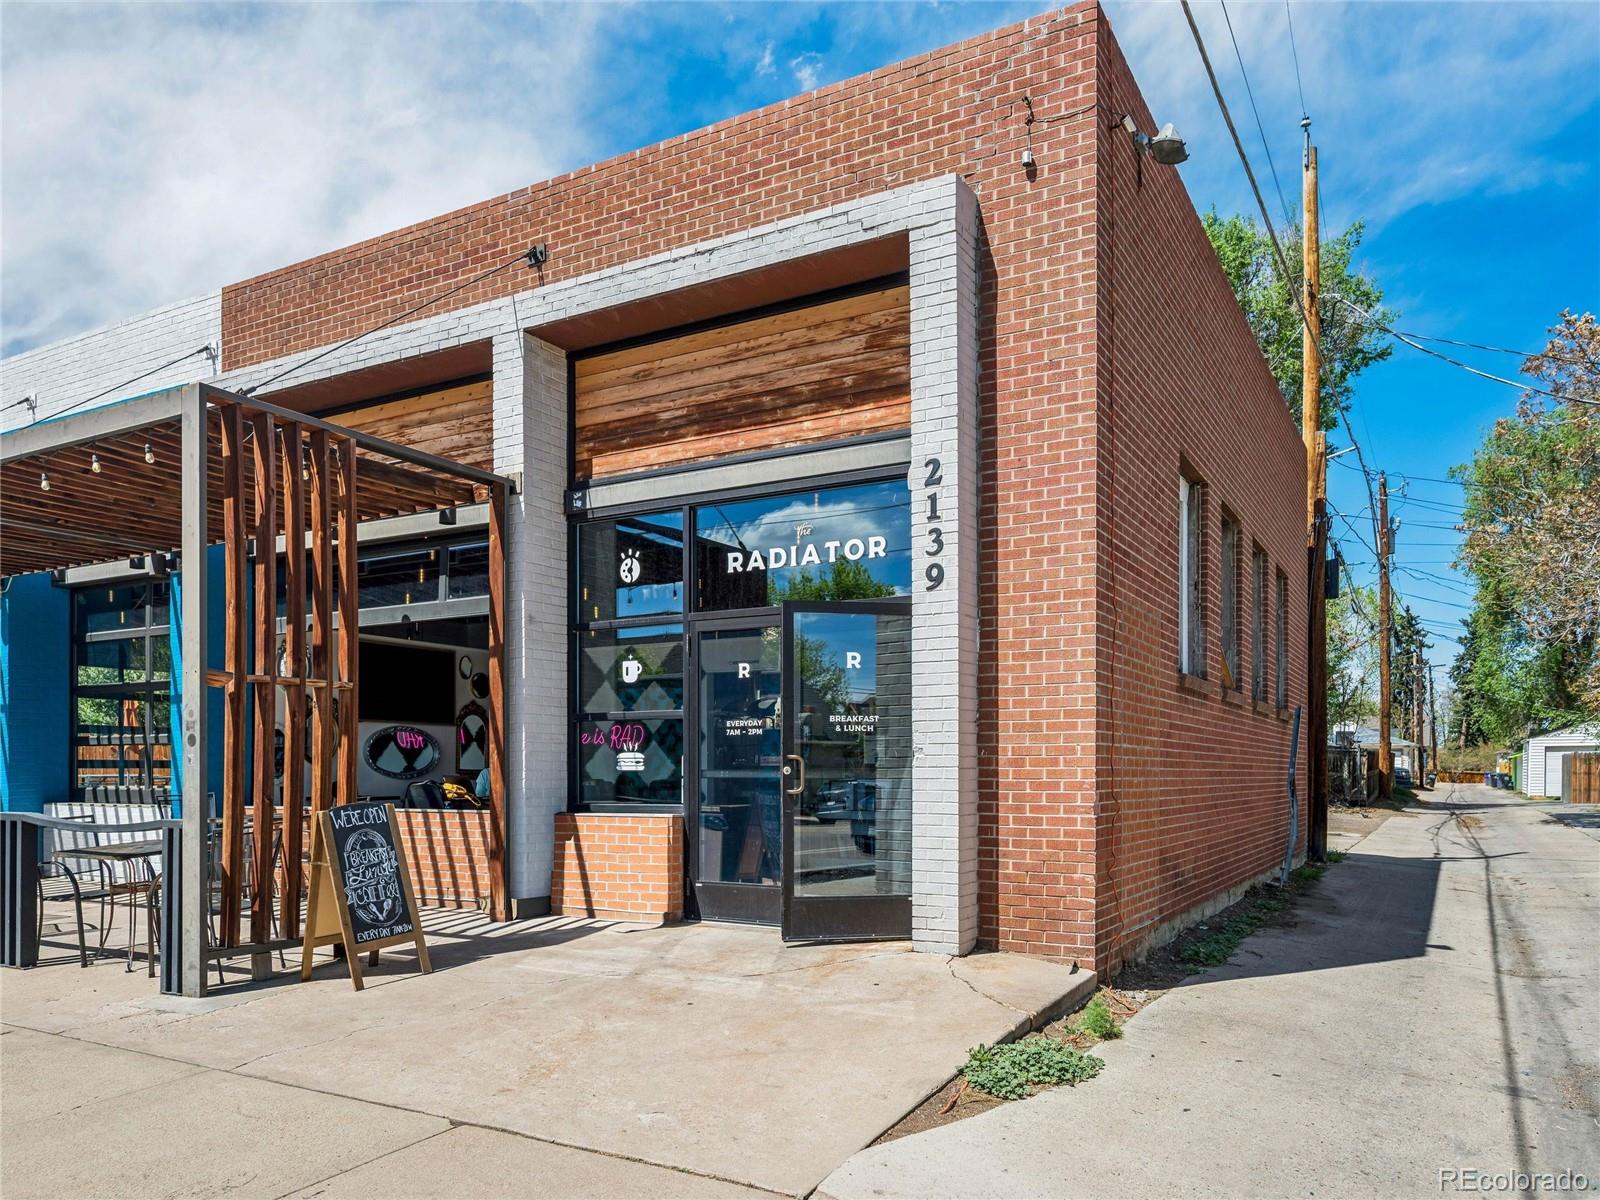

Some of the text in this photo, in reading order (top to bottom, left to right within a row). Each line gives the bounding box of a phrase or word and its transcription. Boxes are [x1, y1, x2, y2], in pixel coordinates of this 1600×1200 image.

[924, 457, 945, 592] 2139
[727, 535, 888, 574] RADIATOR
[846, 651, 862, 669] R
[738, 662, 751, 679] R
[726, 719, 763, 728] EVERYDAY
[829, 714, 880, 723] BREAKFAST
[593, 727, 605, 745] is
[610, 724, 644, 749] RAD
[726, 728, 741, 736] 7AM
[835, 724, 874, 732] & LUNCH
[363, 805, 387, 824] OPEN
